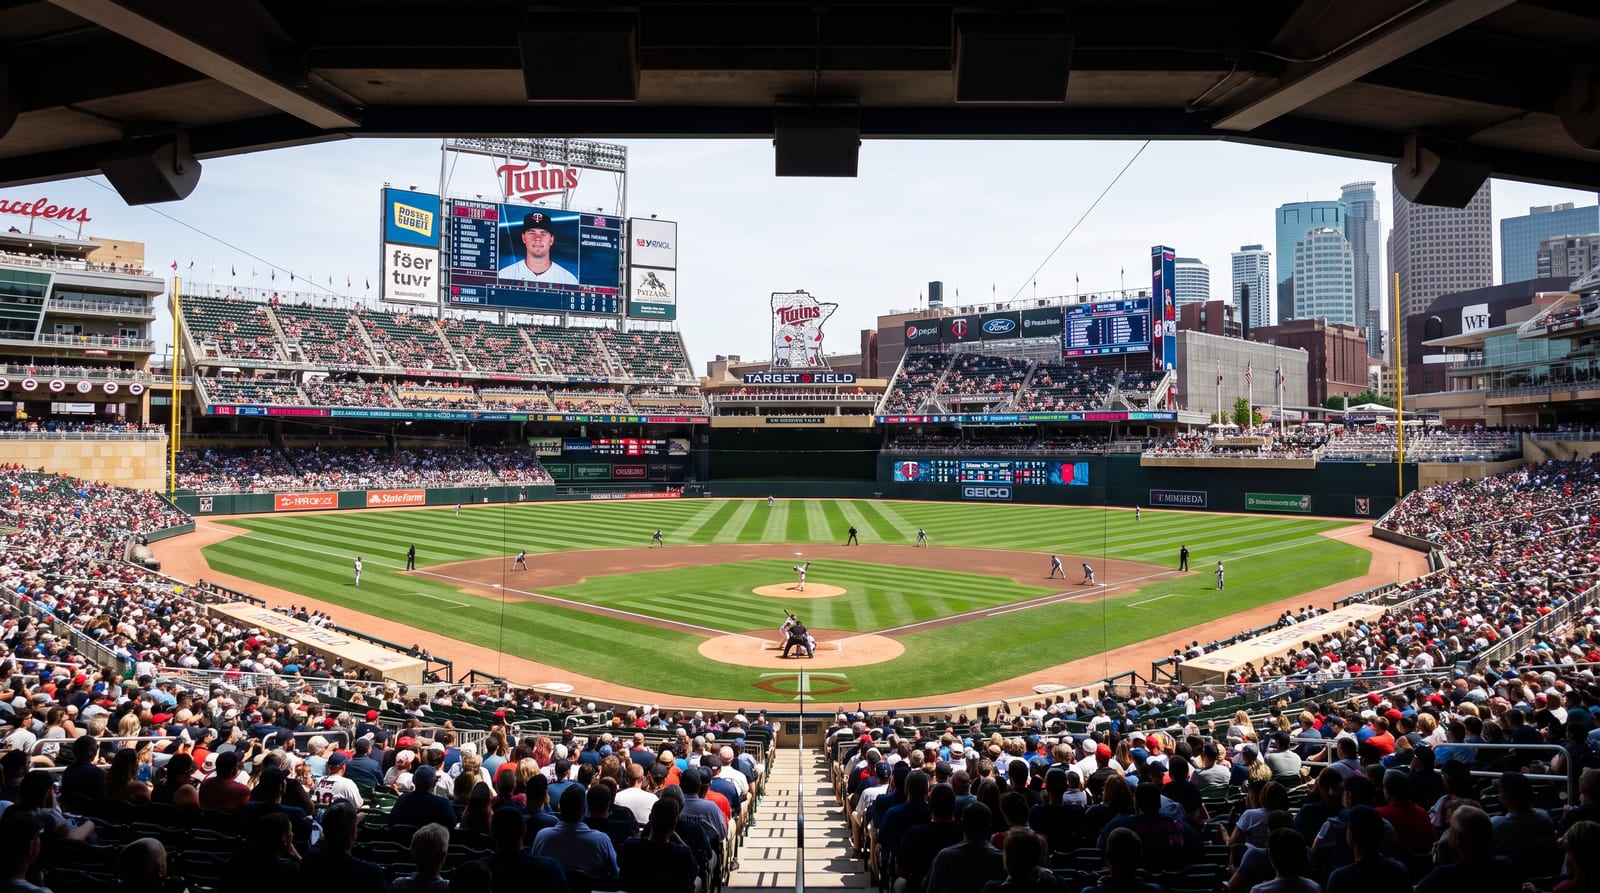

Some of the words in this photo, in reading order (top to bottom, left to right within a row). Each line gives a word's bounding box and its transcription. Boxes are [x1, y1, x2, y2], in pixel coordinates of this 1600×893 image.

[497, 160, 578, 197] Twins
[776, 304, 820, 325] Twins
[918, 326, 938, 336] pepsi
[988, 320, 1009, 332] Ford
[745, 374, 800, 383] TARGET
[814, 374, 853, 383] FIELD
[964, 487, 1009, 498] GEICO
